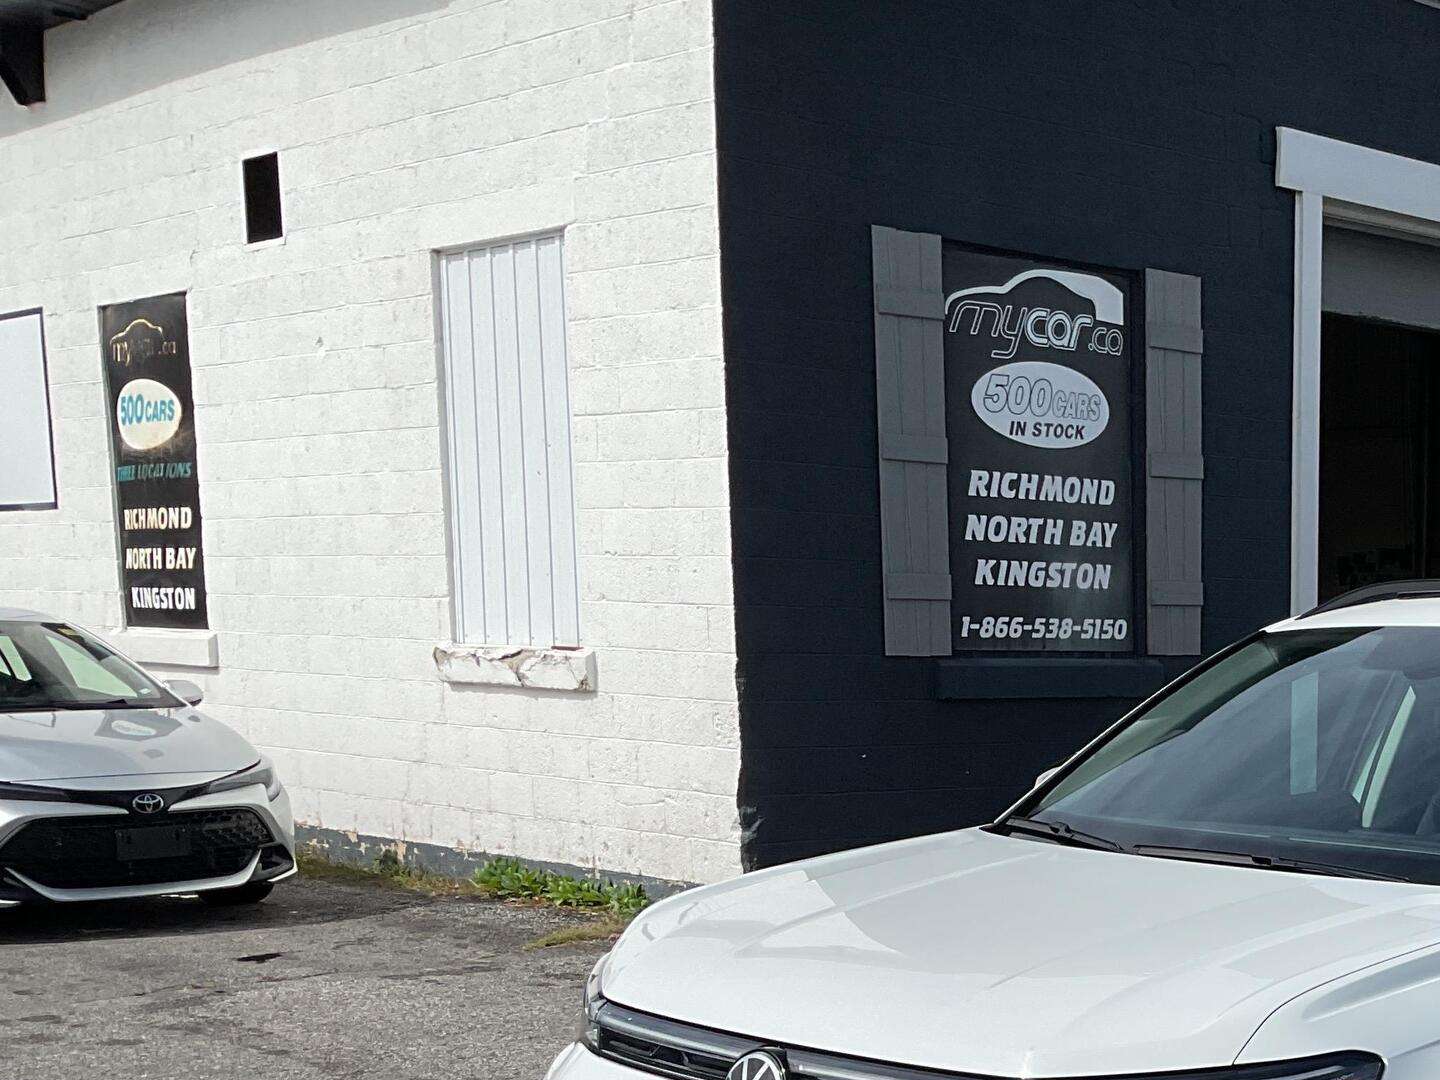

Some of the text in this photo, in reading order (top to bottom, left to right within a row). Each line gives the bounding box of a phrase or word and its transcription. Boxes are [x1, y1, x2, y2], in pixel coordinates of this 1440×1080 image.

[948, 300, 1124, 359] mycar.ca
[1009, 420, 1086, 441] IN STOCK
[968, 469, 1116, 507] RICHMOND
[124, 506, 193, 531] RICHMOND
[965, 514, 1118, 549] NORTH BAY
[126, 547, 197, 570] NORTH BAY
[974, 558, 1112, 590] KINGSTON
[131, 586, 196, 610] KINGSTON
[960, 615, 1128, 641] 1-866-538-5150
